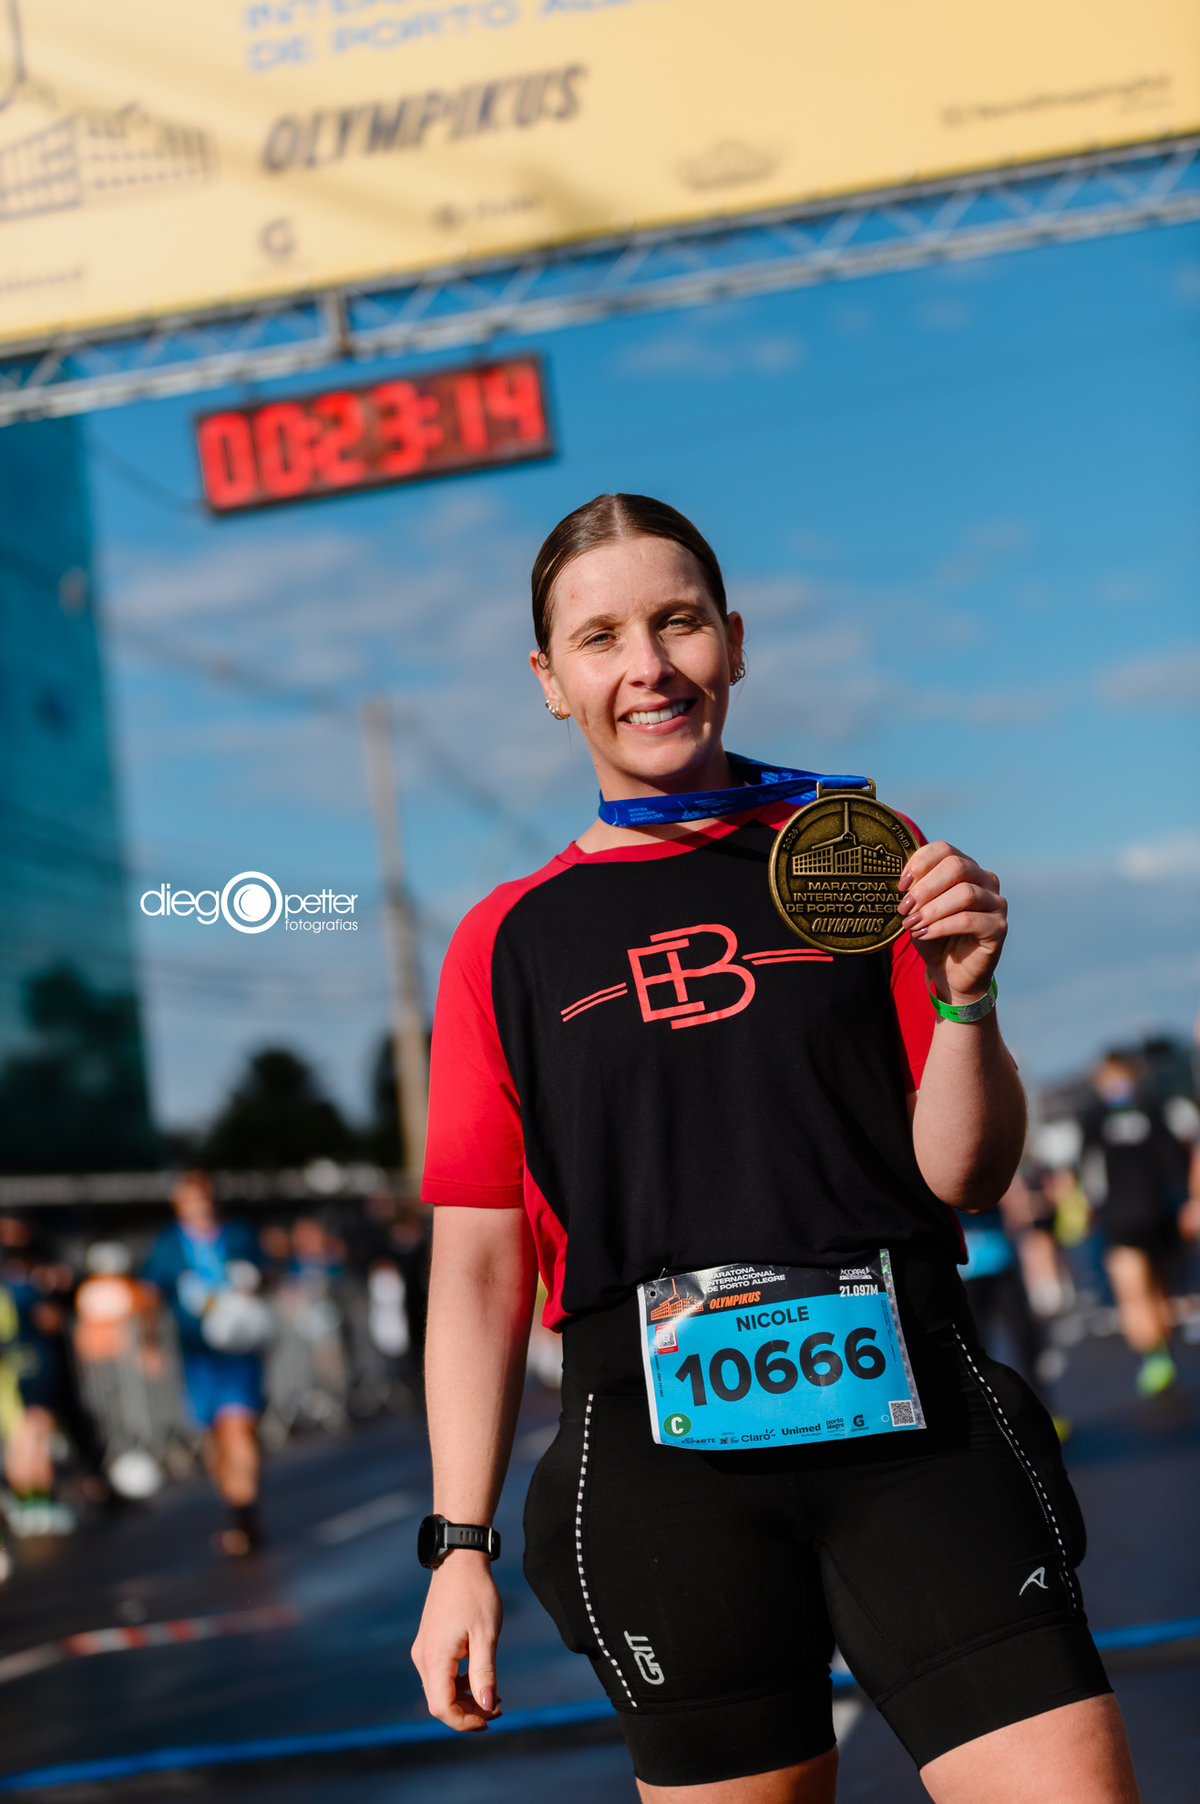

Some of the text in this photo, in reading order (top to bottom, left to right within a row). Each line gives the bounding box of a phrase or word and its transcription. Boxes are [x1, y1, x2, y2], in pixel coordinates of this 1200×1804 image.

[263, 63, 586, 174] OLYMPIKUS
[198, 361, 546, 510] 00:23:14
[808, 882, 888, 891] MARATONA
[793, 893, 902, 902] INTERNACIONAL
[786, 904, 804, 913] DE
[807, 904, 854, 913] PORTO
[811, 917, 884, 933] OLYMPIKUS
[706, 1266, 755, 1280] ARATONA
[707, 1274, 786, 1293] DE PORTO ALEGRE
[839, 1284, 879, 1298] 21.097M
[709, 1291, 761, 1310] OLYMPIKUS
[736, 1306, 810, 1332] NICOLE
[675, 1327, 886, 1406] 10666
[670, 1416, 684, 1435] C
[781, 1423, 822, 1436] Unimed
[741, 1431, 773, 1443] Claro
[623, 1630, 665, 1685] GRIT
